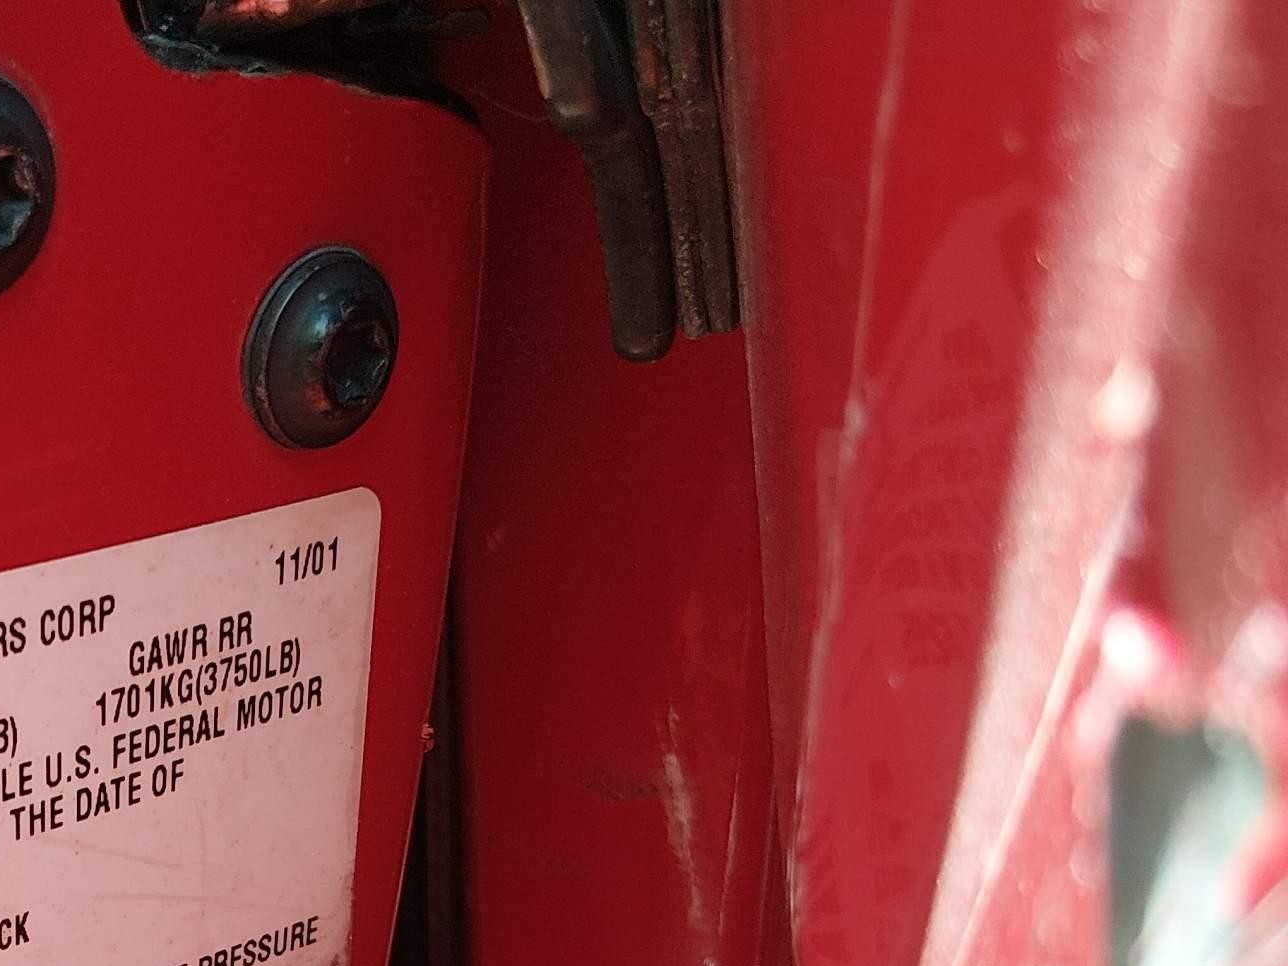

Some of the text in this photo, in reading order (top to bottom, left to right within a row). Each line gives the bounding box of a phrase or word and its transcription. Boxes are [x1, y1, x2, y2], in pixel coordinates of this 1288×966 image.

[274, 535, 339, 586] 11/01
[40, 593, 116, 647] CORP
[128, 610, 253, 678] GAWR RR
[95, 636, 301, 727] 1701KG(3750LB)
[45, 744, 100, 789] U.S.
[112, 705, 226, 770] FEDERAL
[236, 675, 323, 732] MOTOR
[9, 793, 64, 841] THE
[75, 770, 142, 823] DATE
[151, 757, 185, 798] OF
